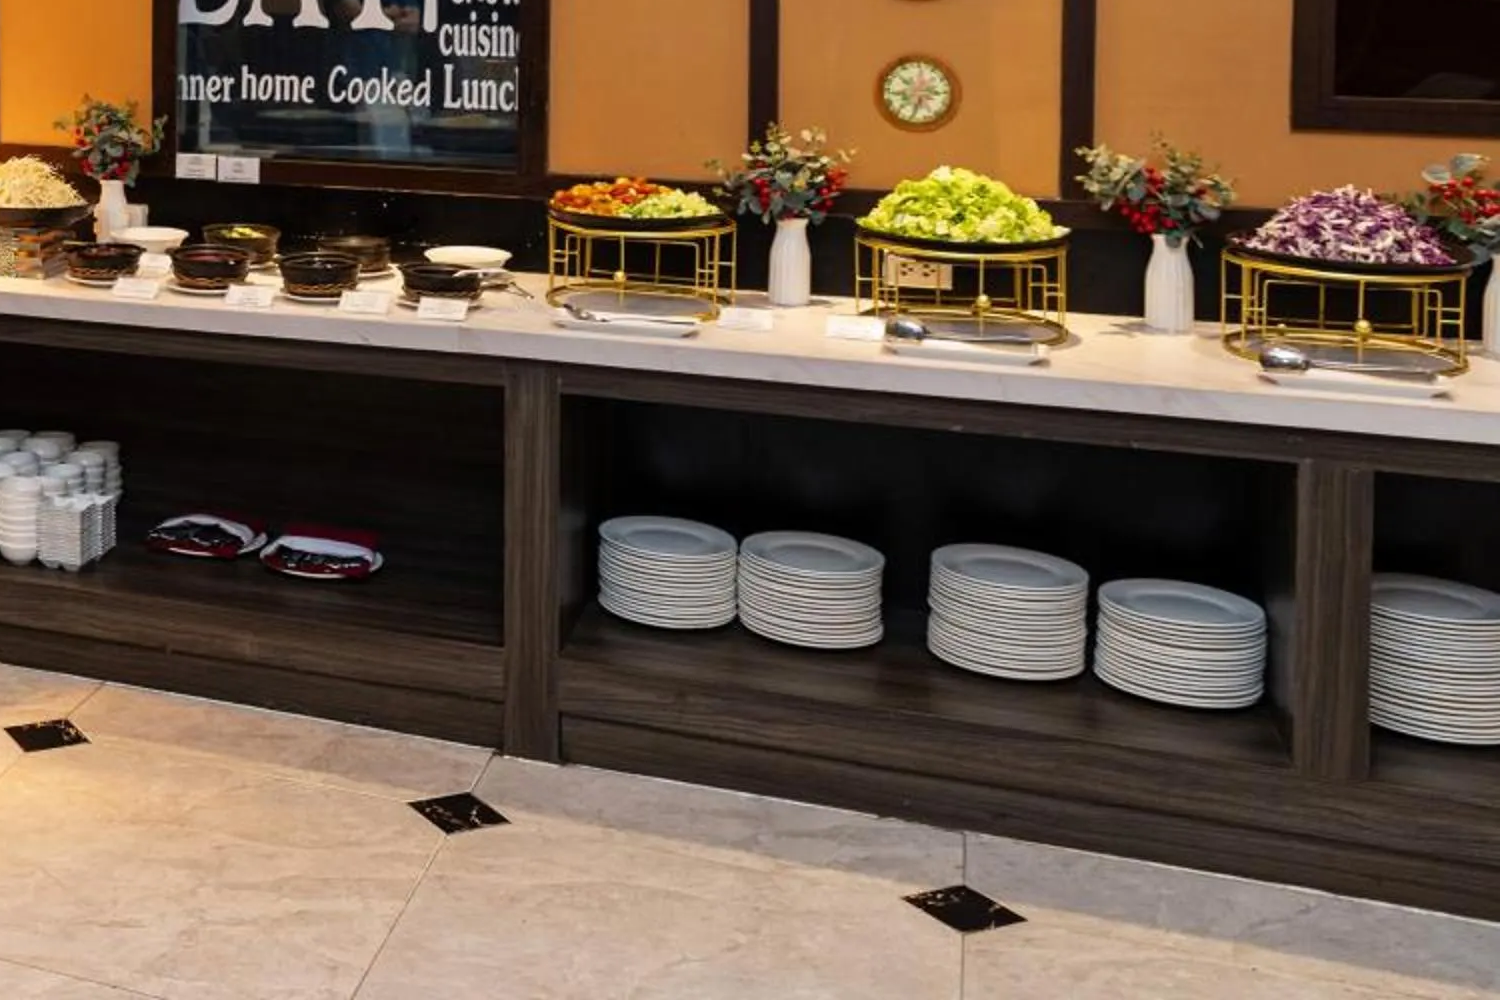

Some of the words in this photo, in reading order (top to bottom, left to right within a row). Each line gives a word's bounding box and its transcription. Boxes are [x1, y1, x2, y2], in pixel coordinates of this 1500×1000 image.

[438, 11, 519, 57] cuisin
[241, 64, 316, 103] home
[327, 65, 431, 107] Cooked
